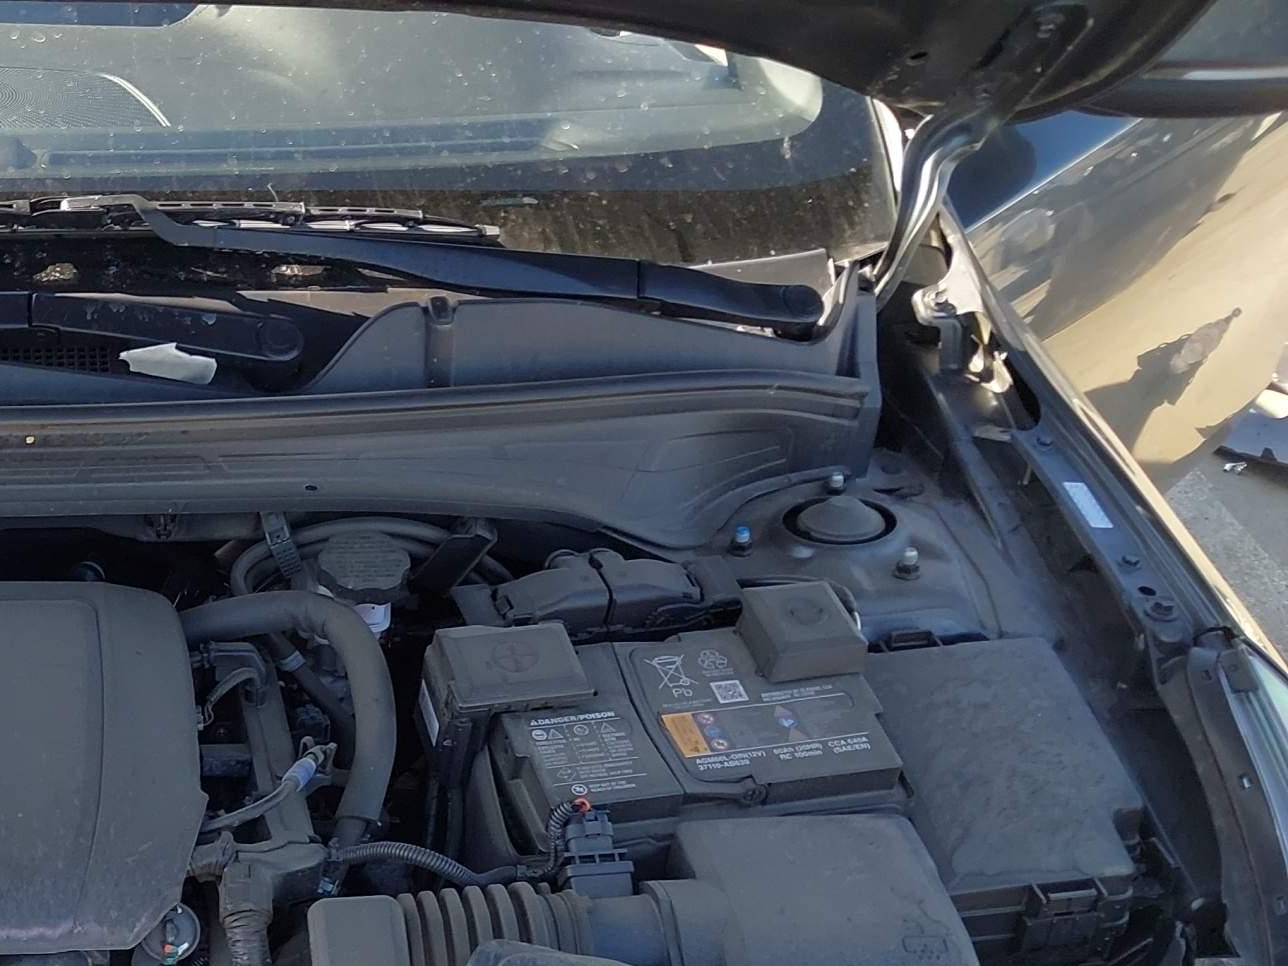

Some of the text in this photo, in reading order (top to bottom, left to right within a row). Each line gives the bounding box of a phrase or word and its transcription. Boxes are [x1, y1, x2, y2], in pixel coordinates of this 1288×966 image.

[672, 687, 693, 698] Pb
[538, 710, 616, 726] DANGER/POISON
[827, 739, 847, 747] CCA
